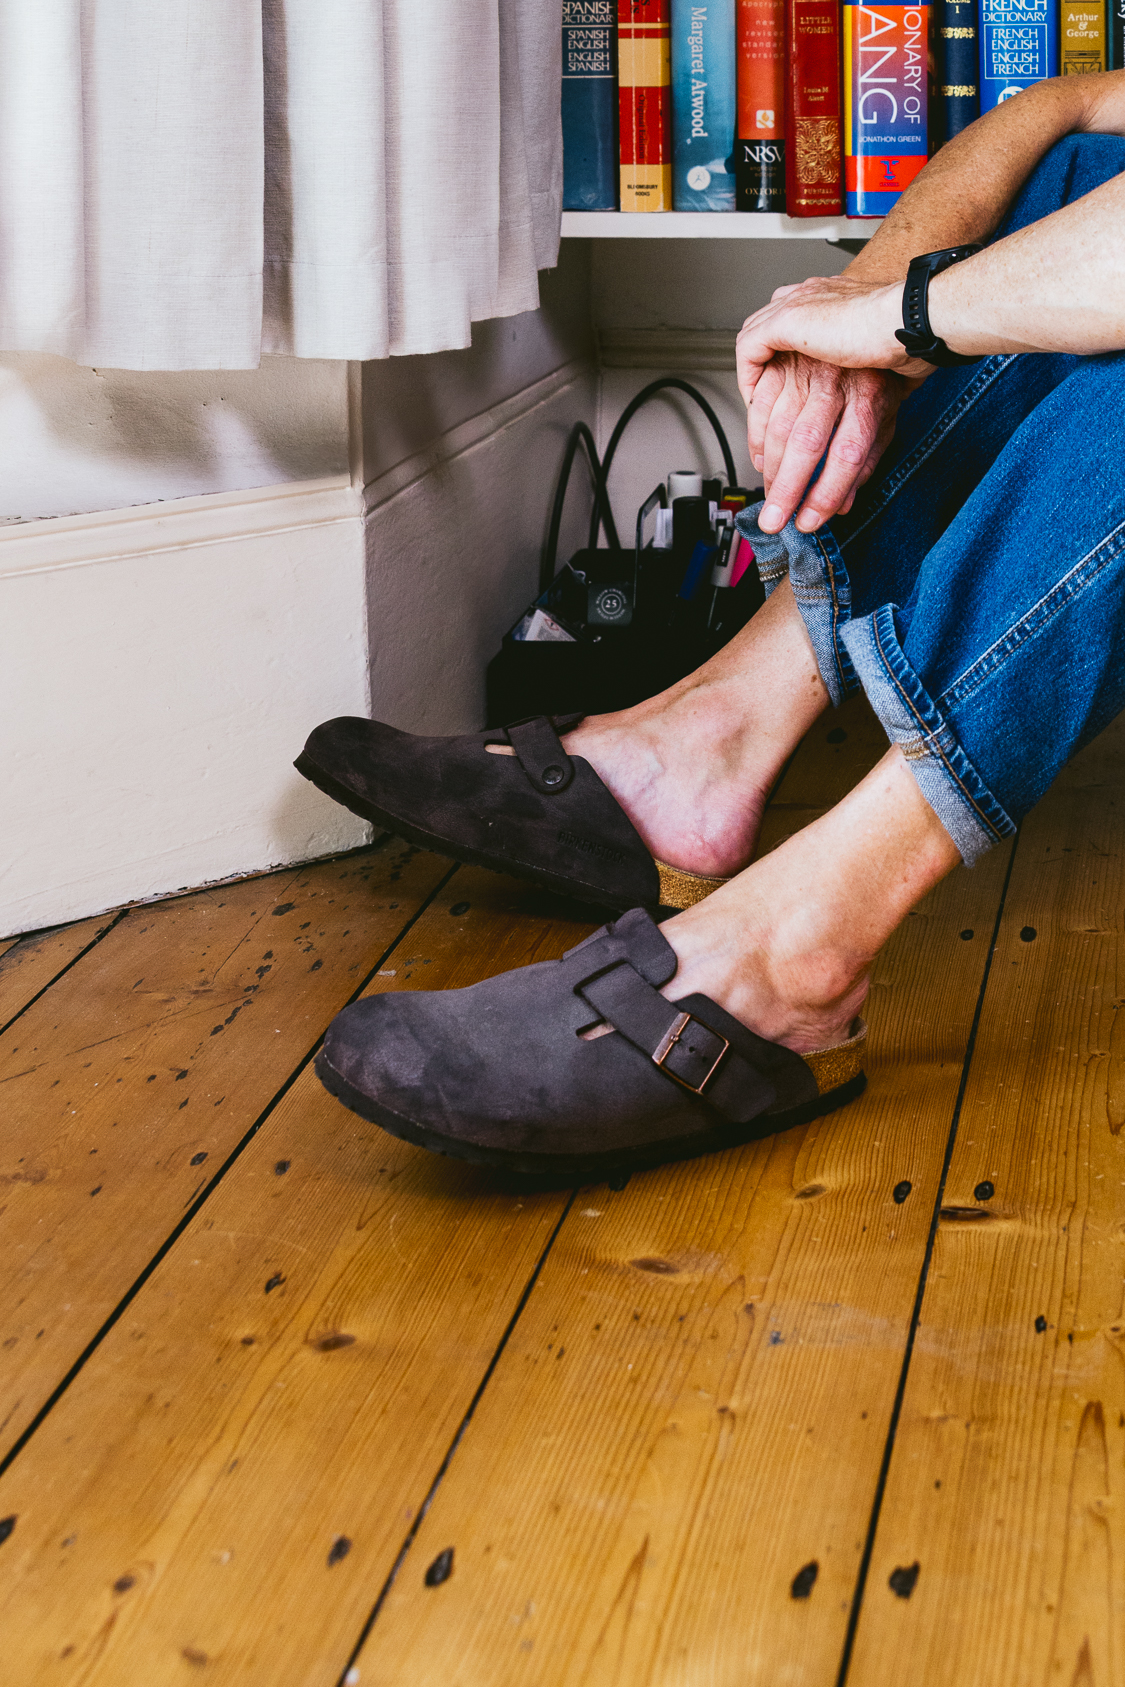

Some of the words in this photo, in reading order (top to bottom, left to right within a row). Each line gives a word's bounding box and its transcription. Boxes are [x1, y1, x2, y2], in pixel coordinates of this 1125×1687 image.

[982, 12, 1047, 22] DICTIONARY
[1067, 13, 1099, 22] Arthur
[992, 28, 1038, 39] FRENCH
[1066, 29, 1099, 39] George
[568, 40, 609, 49] ENGLISH
[688, 7, 707, 74] Margaret
[992, 39, 1039, 50] ENGLISH
[568, 62, 609, 71] SPANISH
[691, 79, 708, 138] Atwood
[903, 97, 921, 124] OF
[605, 599, 617, 608] 25
